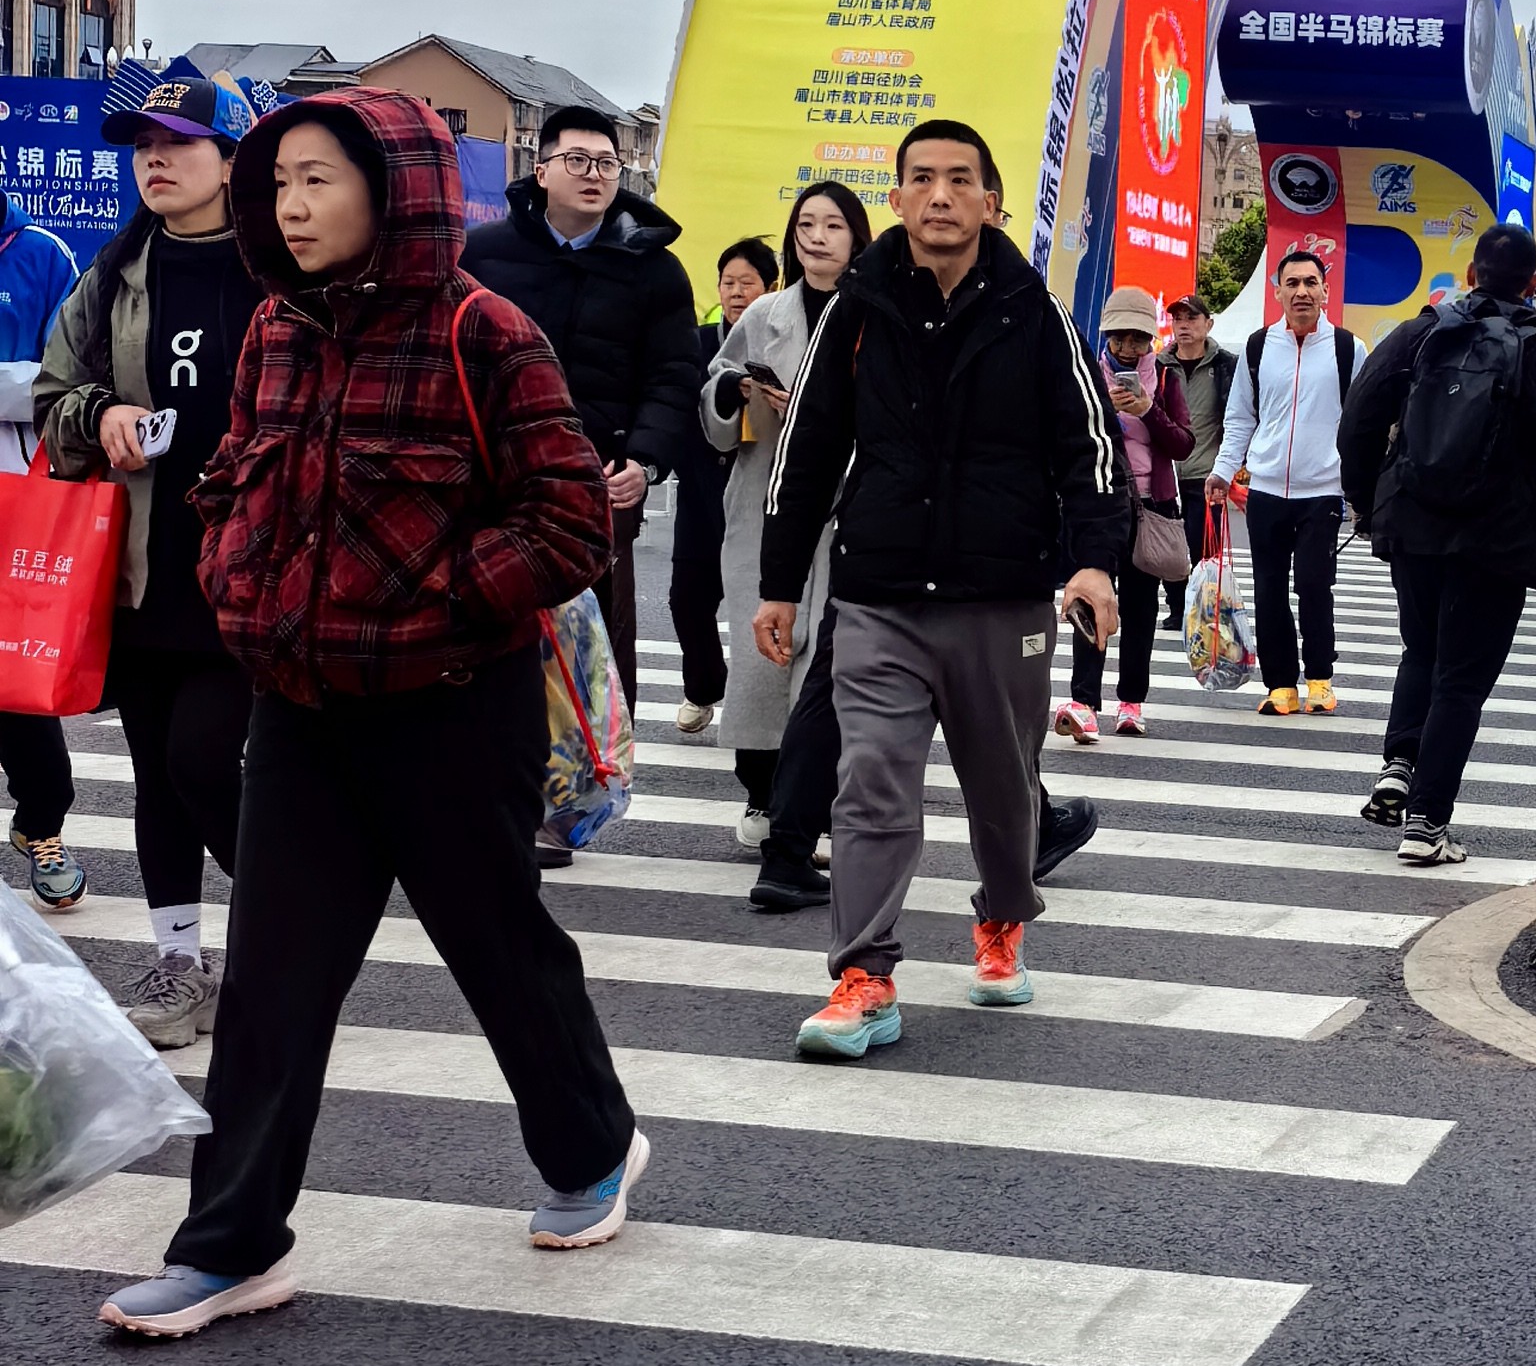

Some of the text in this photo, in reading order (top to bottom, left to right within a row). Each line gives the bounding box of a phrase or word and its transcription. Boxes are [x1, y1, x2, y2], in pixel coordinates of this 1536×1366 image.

[826, 12, 936, 30] 眉山市人民政府
[1239, 10, 1444, 48] 全国半马锦标赛
[840, 49, 906, 66] 承办单位
[812, 69, 924, 88] 四川省田径协会
[794, 88, 937, 109] 眉山市教育和体育局
[806, 108, 917, 127] 仁寿县人民政府
[822, 144, 888, 161] 协办单位
[1378, 200, 1417, 214] AIMS
